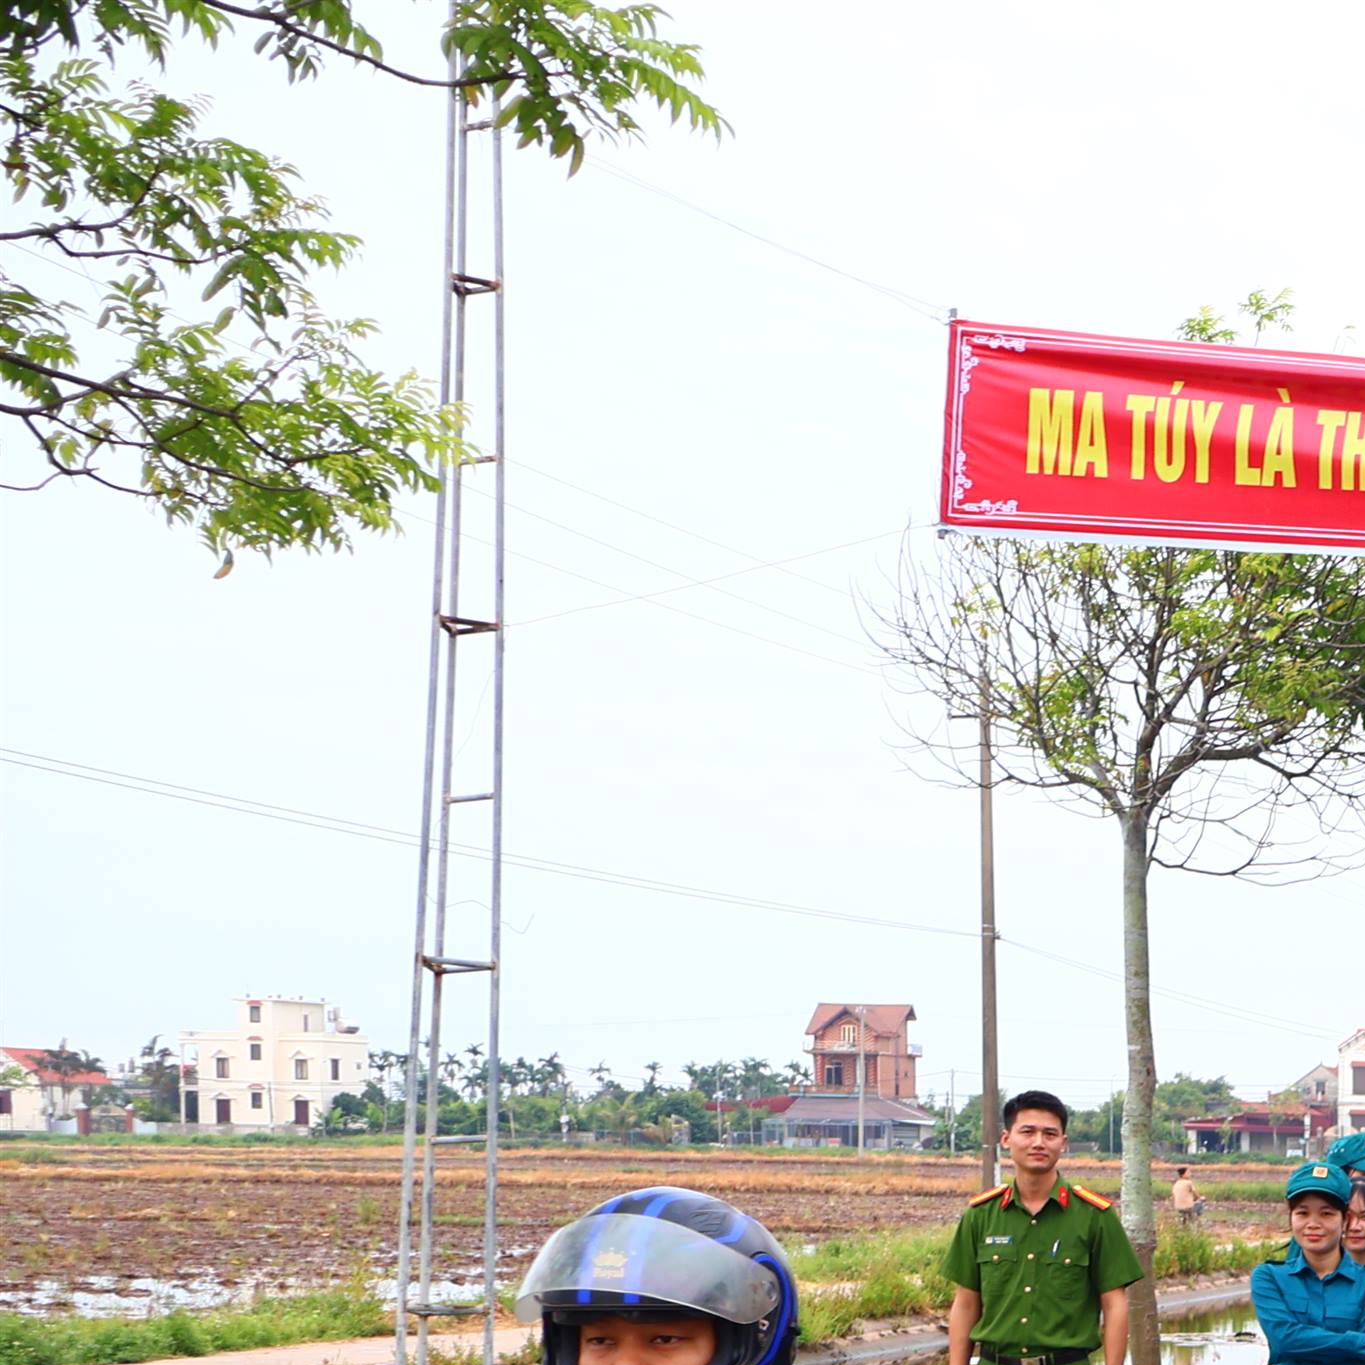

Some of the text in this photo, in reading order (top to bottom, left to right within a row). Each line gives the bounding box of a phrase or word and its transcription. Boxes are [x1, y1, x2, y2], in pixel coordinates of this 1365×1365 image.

[1025, 387, 1109, 478] MA
[1125, 380, 1223, 484] TÚY
[1234, 388, 1297, 488] LÀ
